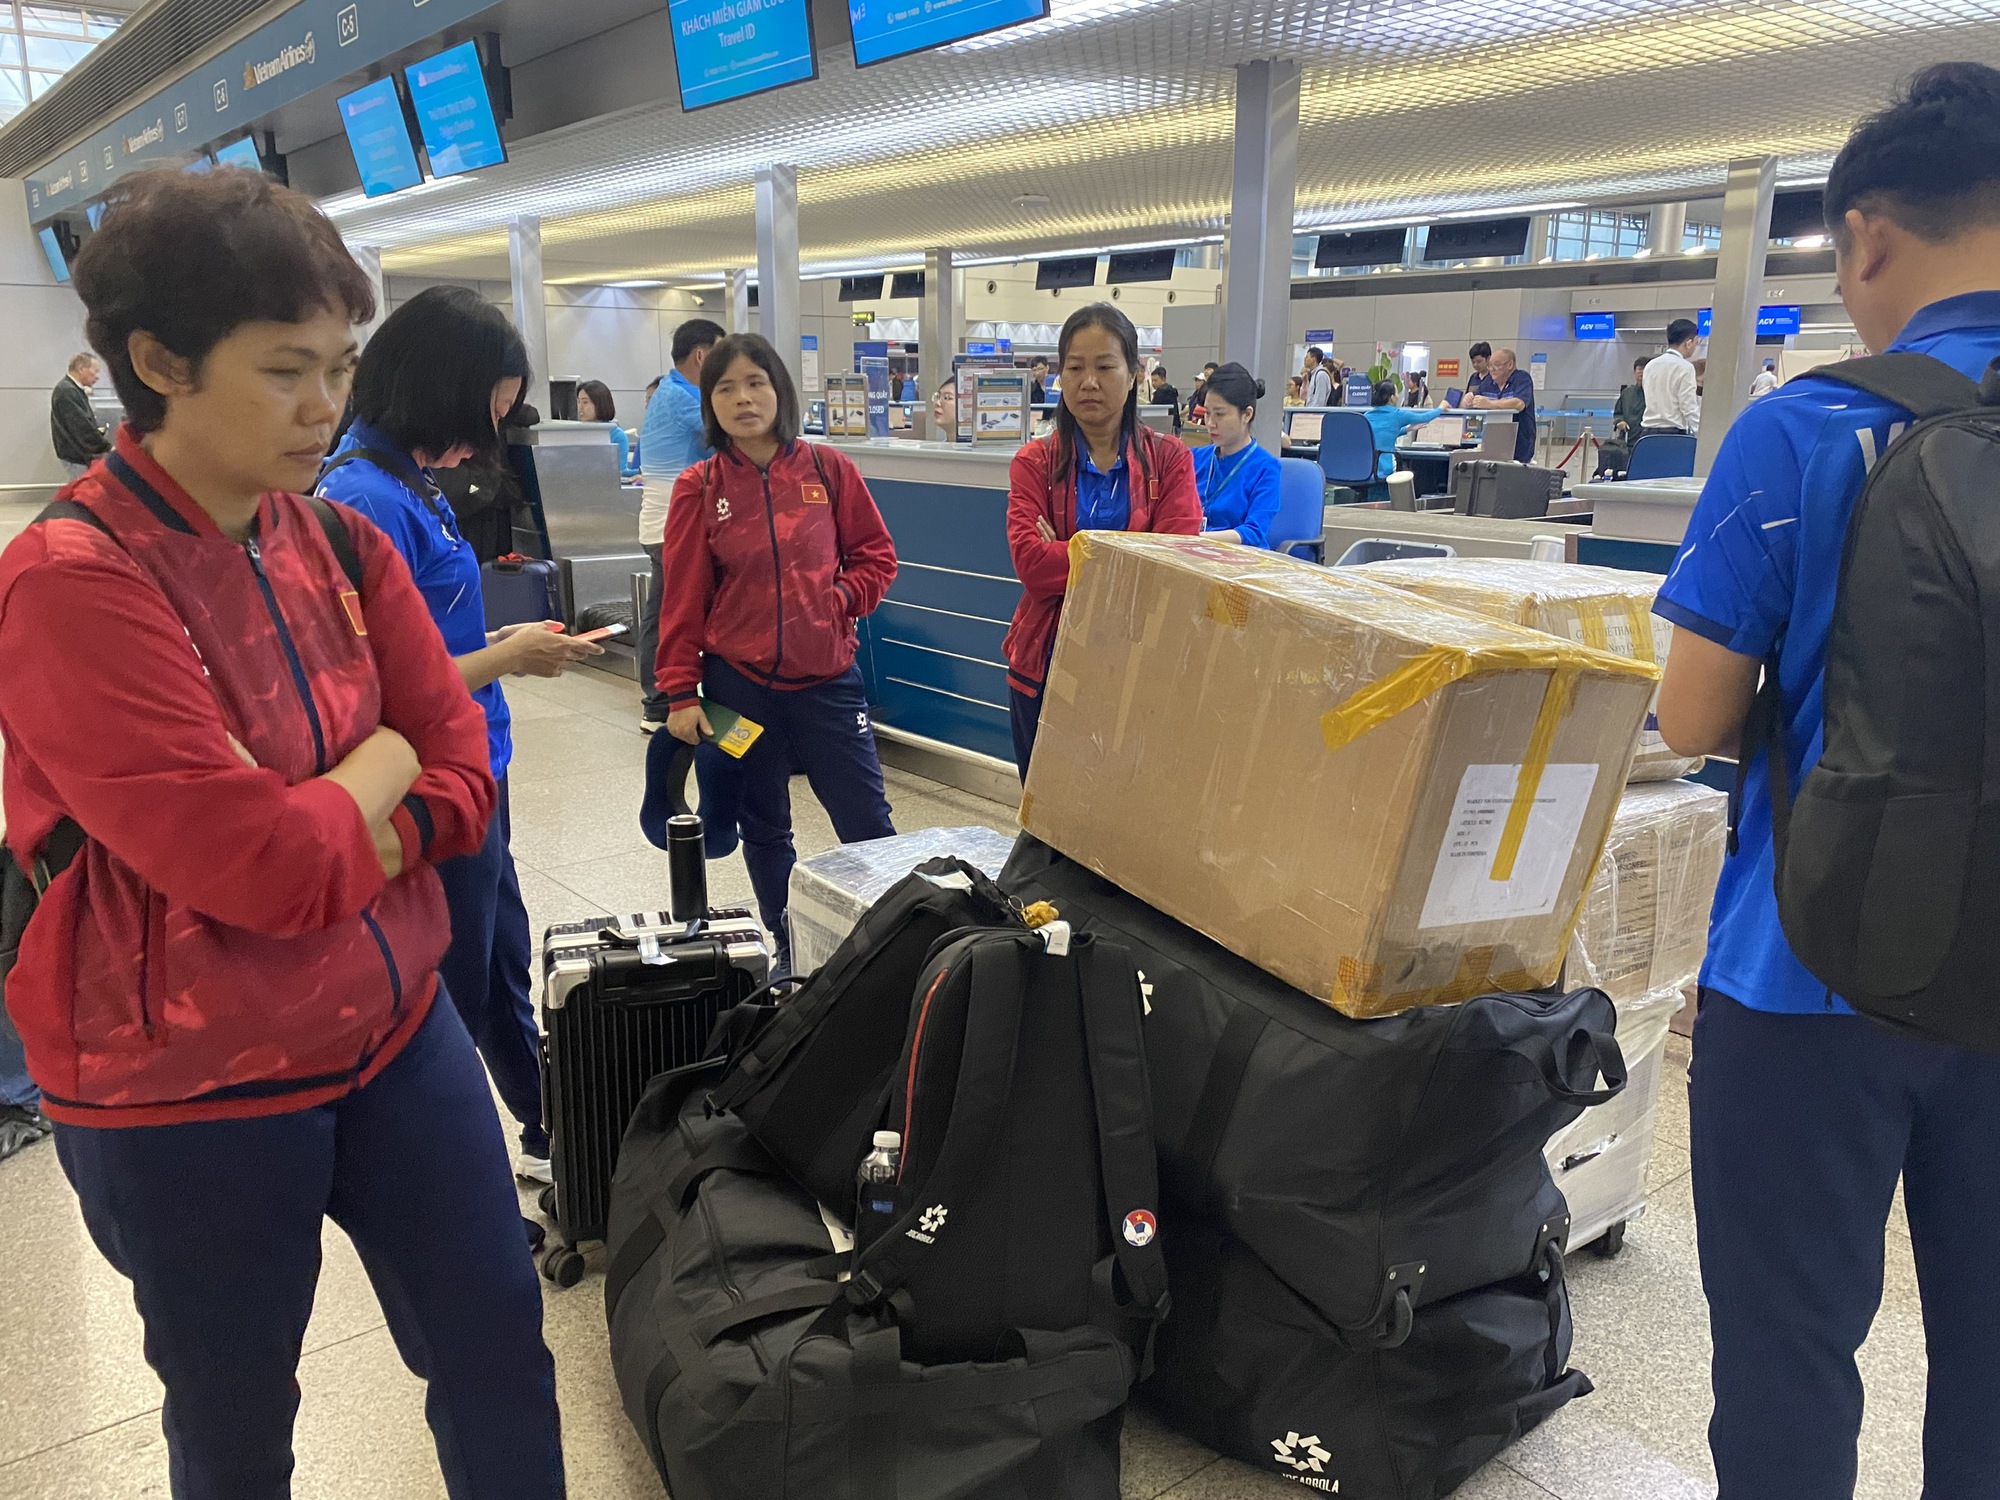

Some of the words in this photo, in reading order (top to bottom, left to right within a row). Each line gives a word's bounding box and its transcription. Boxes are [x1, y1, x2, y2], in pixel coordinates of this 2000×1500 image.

[341, 15, 354, 37] C-5
[681, 13, 711, 36] KHÁCH
[718, 26, 744, 48] Travel
[745, 22, 756, 39] ID
[868, 405, 885, 414] LOSED
